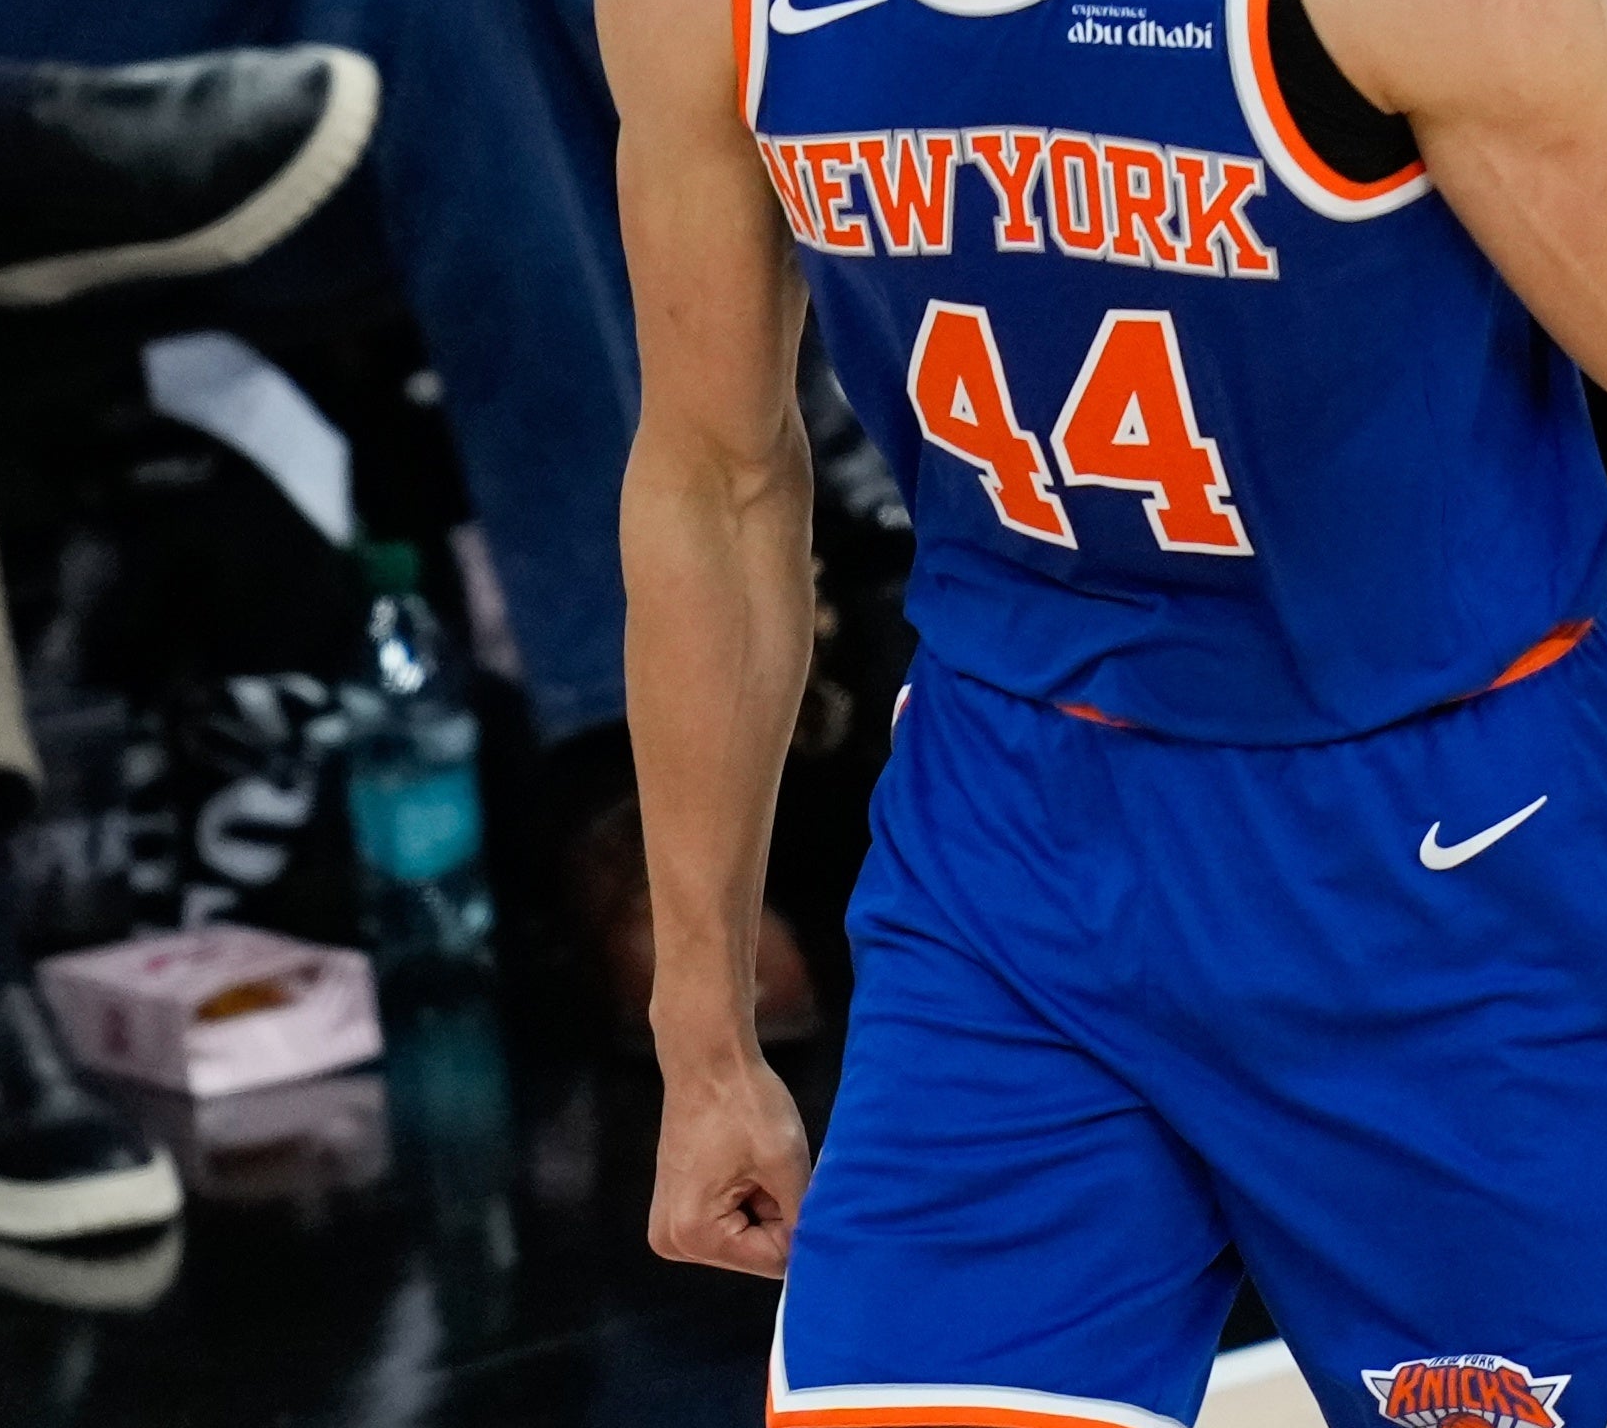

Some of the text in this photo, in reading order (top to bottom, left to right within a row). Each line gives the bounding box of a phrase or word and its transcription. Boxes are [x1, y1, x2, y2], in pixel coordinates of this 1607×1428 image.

[1071, 3, 1147, 19] experience
[1067, 16, 1213, 50] abu dhabi
[756, 125, 1280, 280] NEW YORK
[907, 298, 1254, 556] 44
[1428, 1354, 1496, 1369] NEW YORK
